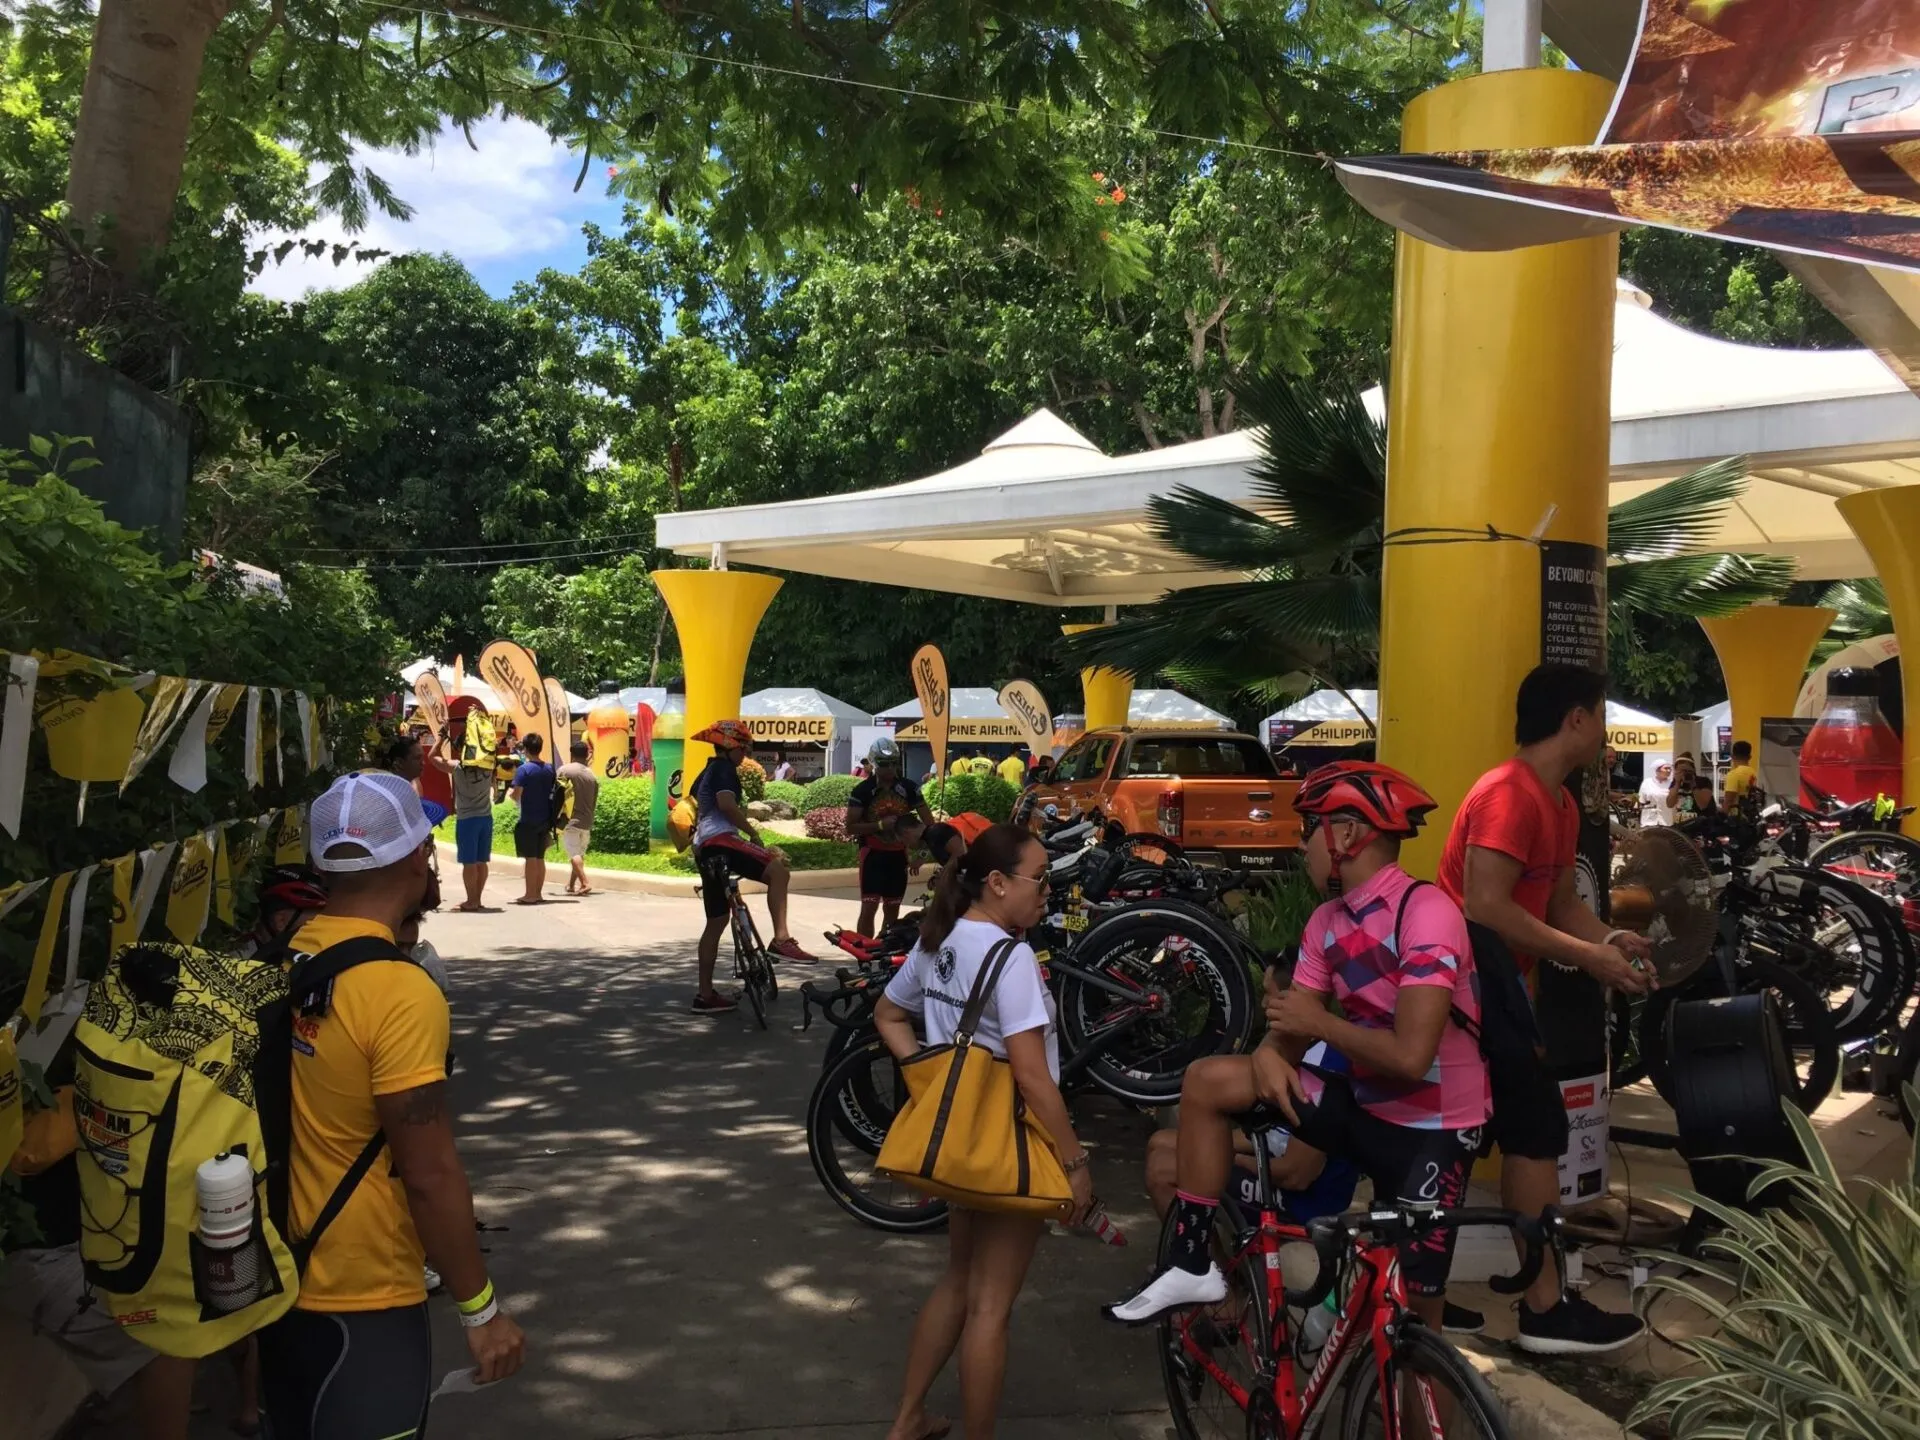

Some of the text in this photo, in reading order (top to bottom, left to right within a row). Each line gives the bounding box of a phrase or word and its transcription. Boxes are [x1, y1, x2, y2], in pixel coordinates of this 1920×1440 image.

[1547, 566, 1585, 583] BEYOND
[1548, 601, 1562, 610] THE
[1564, 602, 1588, 612] COFFEE
[1547, 613, 1573, 621] ABOUT
[1547, 635, 1578, 643] CYCLING
[1546, 646, 1574, 654] EXPERT
[743, 720, 826, 736] MOTORACE
[1241, 855, 1274, 865] Ranger
[1065, 914, 1087, 928] 1955
